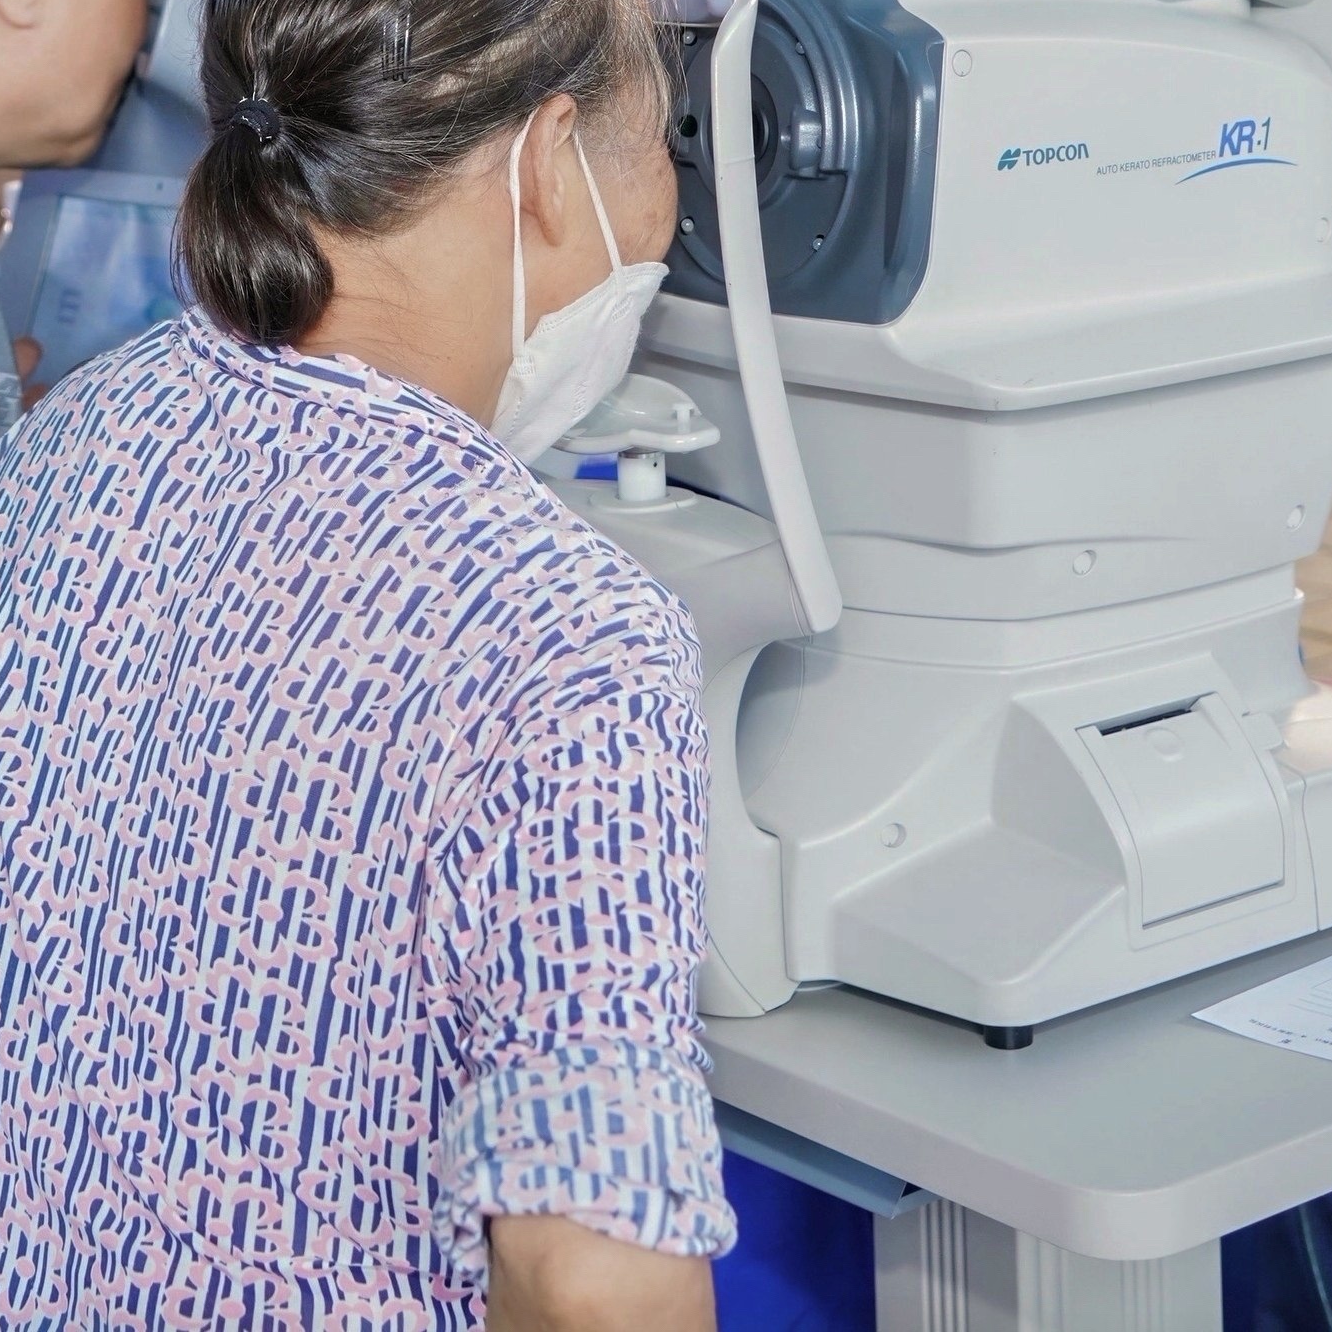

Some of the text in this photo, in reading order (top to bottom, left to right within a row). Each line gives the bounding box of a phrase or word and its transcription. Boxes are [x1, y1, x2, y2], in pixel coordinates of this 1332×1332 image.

[1022, 142, 1090, 167] TOPCON
[1096, 149, 1217, 176] AUTO KERATO REFRACTOMETER
